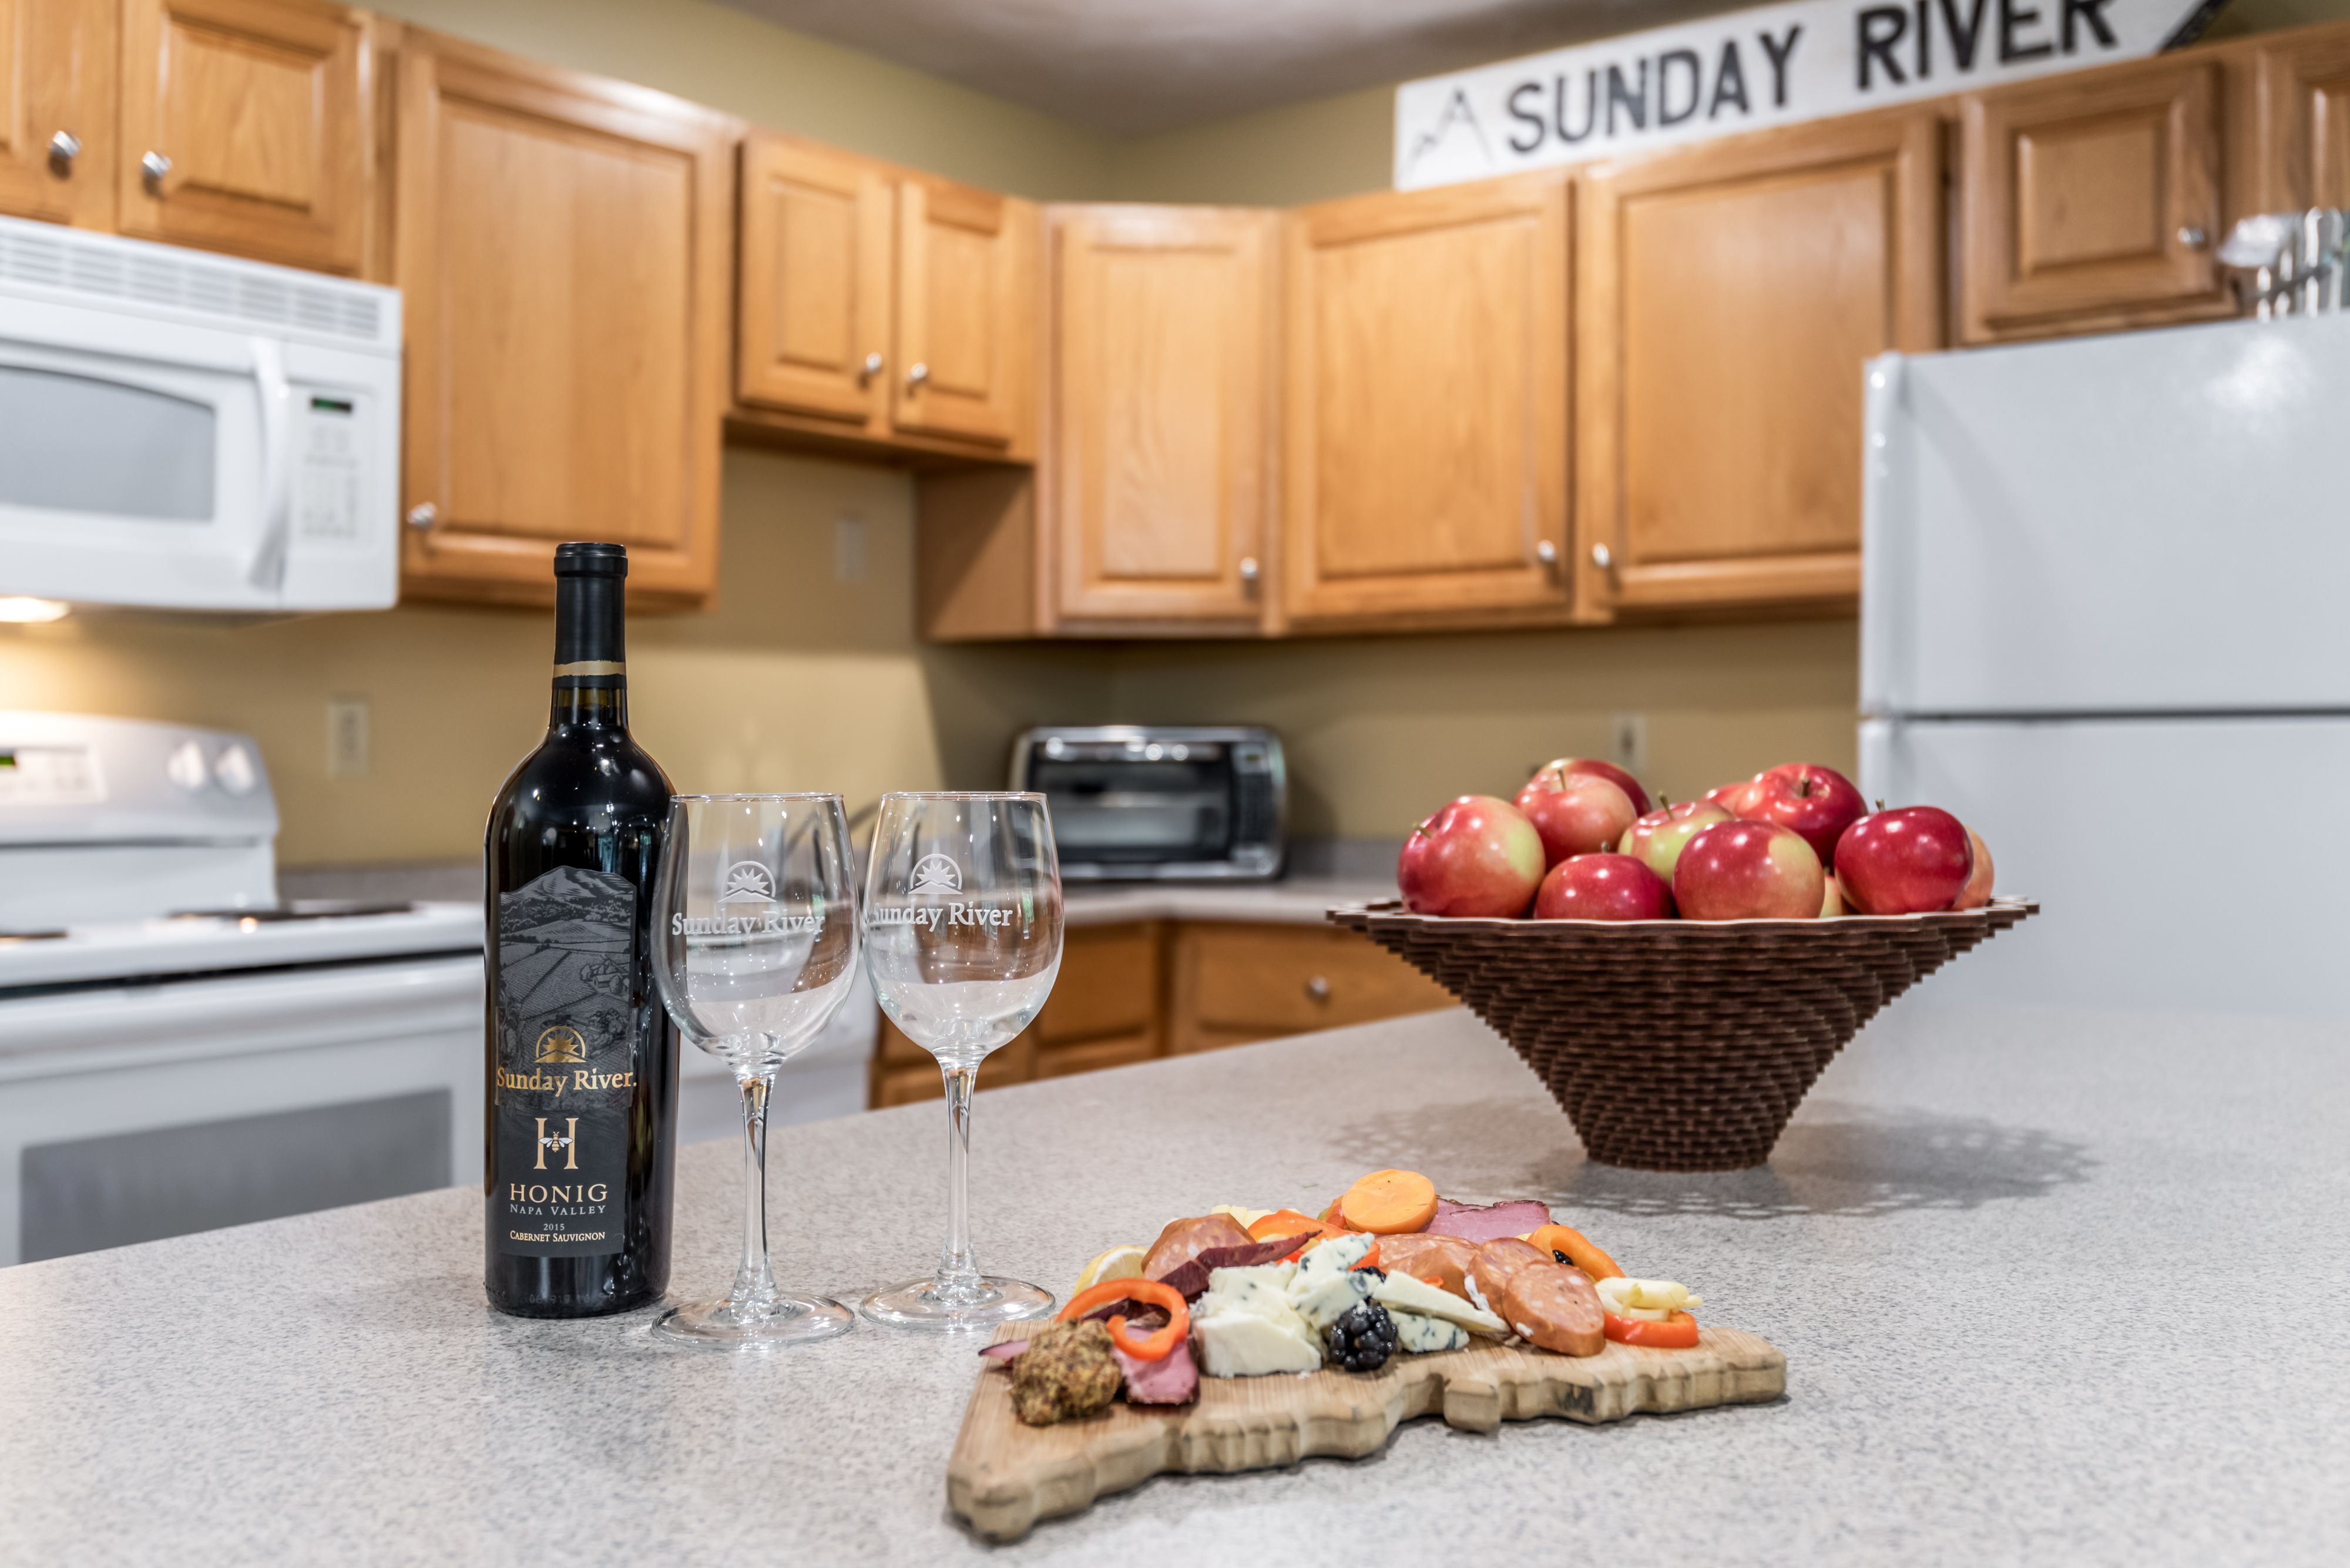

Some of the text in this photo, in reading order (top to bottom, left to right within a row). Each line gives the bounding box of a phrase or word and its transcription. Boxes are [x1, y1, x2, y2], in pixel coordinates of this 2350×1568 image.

[1506, 0, 2119, 155] SUNDAY RIVER
[672, 908, 825, 939] Sunday River
[871, 901, 1013, 932] Sunday River
[496, 1067, 568, 1097] Sunday
[509, 1183, 608, 1203] HONIG
[509, 1204, 606, 1216] NAPA VALLEY
[509, 1230, 606, 1242] CABERNET SAUVIGNON
[543, 1223, 565, 1231] 2015
